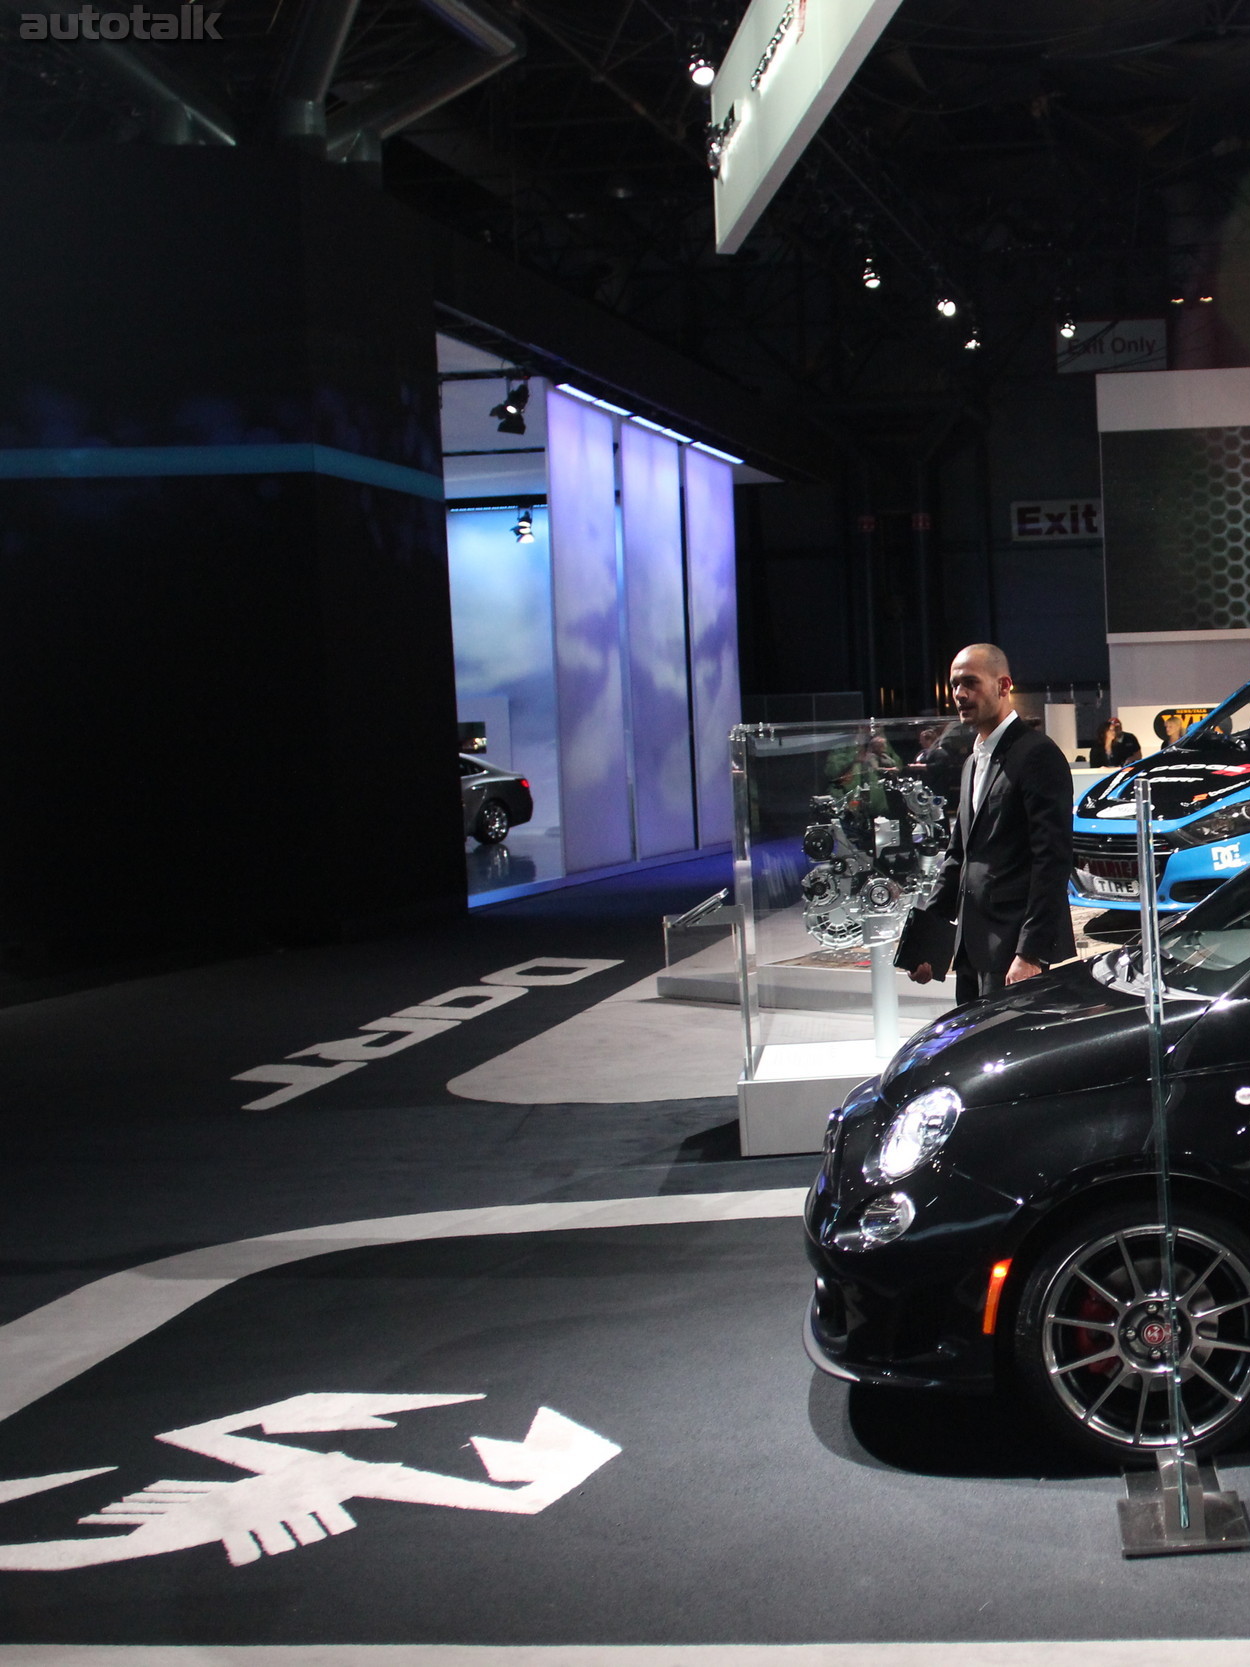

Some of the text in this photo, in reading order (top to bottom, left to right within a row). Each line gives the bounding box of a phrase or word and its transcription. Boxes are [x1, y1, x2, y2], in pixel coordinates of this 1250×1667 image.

[1067, 337, 1156, 356] Exit Only
[1017, 504, 1098, 536] Exit
[1150, 763, 1246, 773] DODGE
[1097, 879, 1135, 894] TIRE
